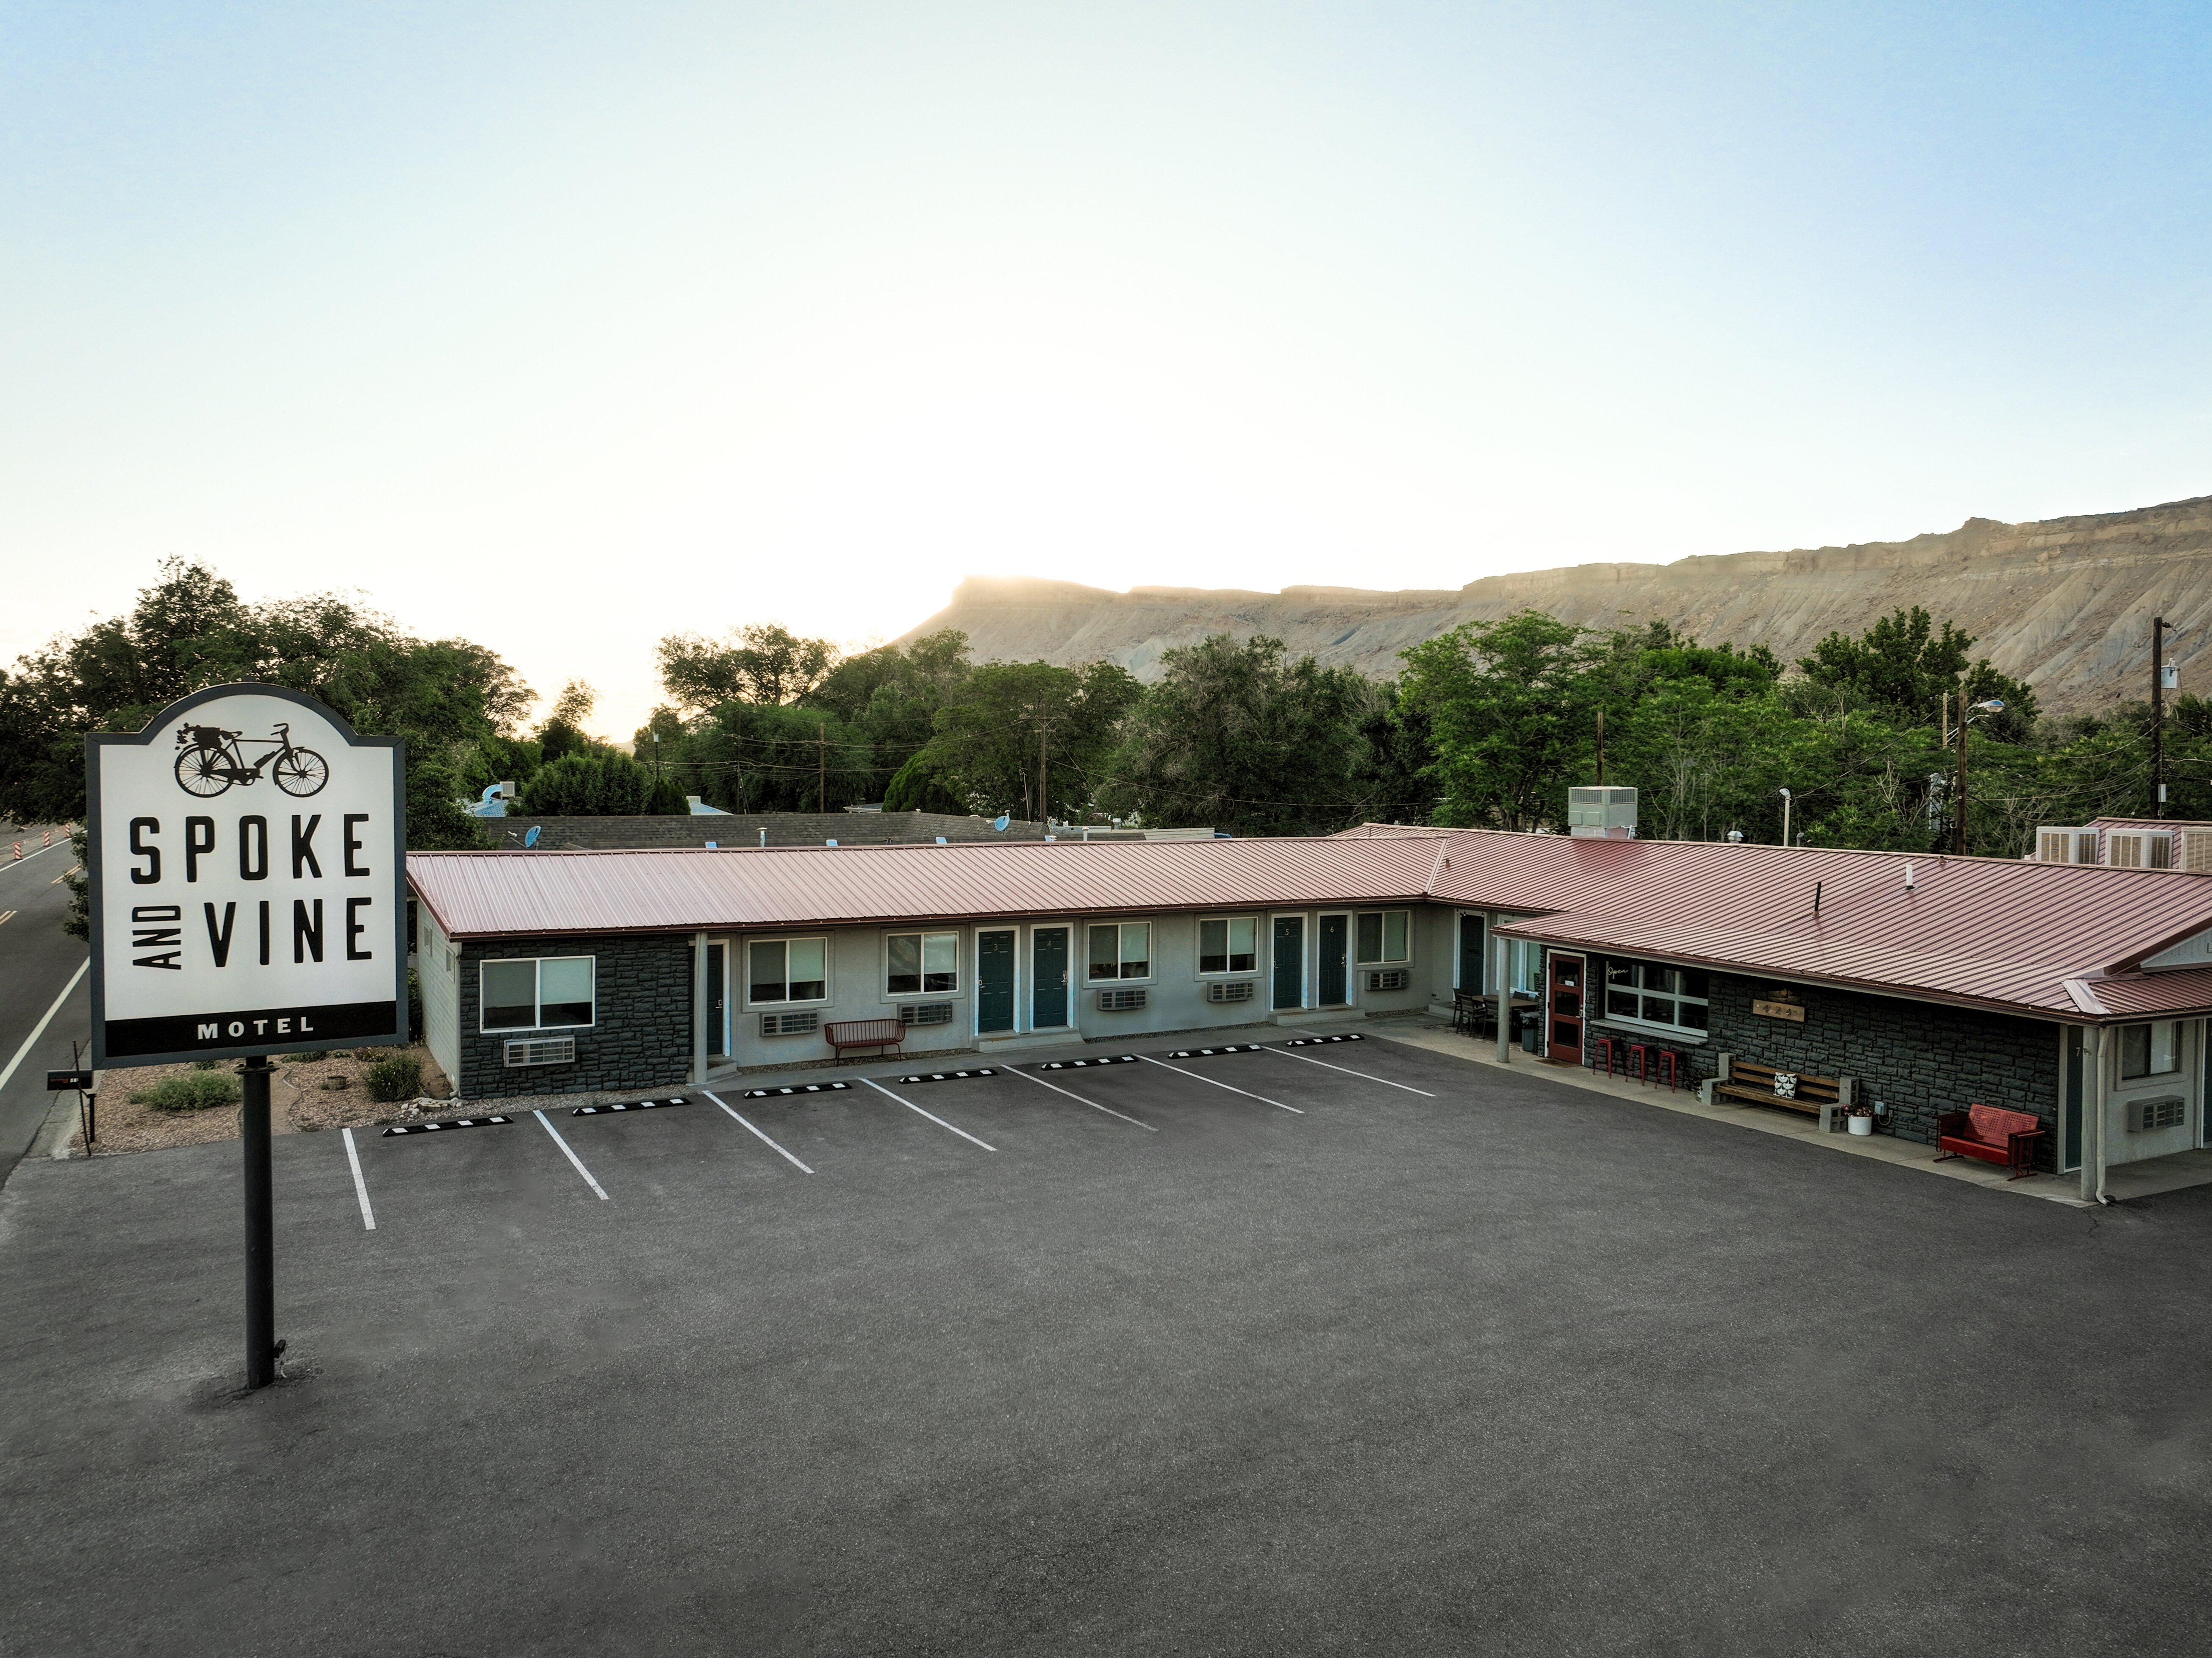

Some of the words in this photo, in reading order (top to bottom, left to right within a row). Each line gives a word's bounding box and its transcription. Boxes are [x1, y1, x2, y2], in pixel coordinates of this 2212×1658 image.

[130, 814, 370, 884] SPOKE
[132, 905, 181, 970] AND
[204, 897, 372, 968] VINE
[994, 943, 998, 951] 3
[1607, 967, 1628, 979] Open
[197, 1017, 313, 1039] MOTEL
